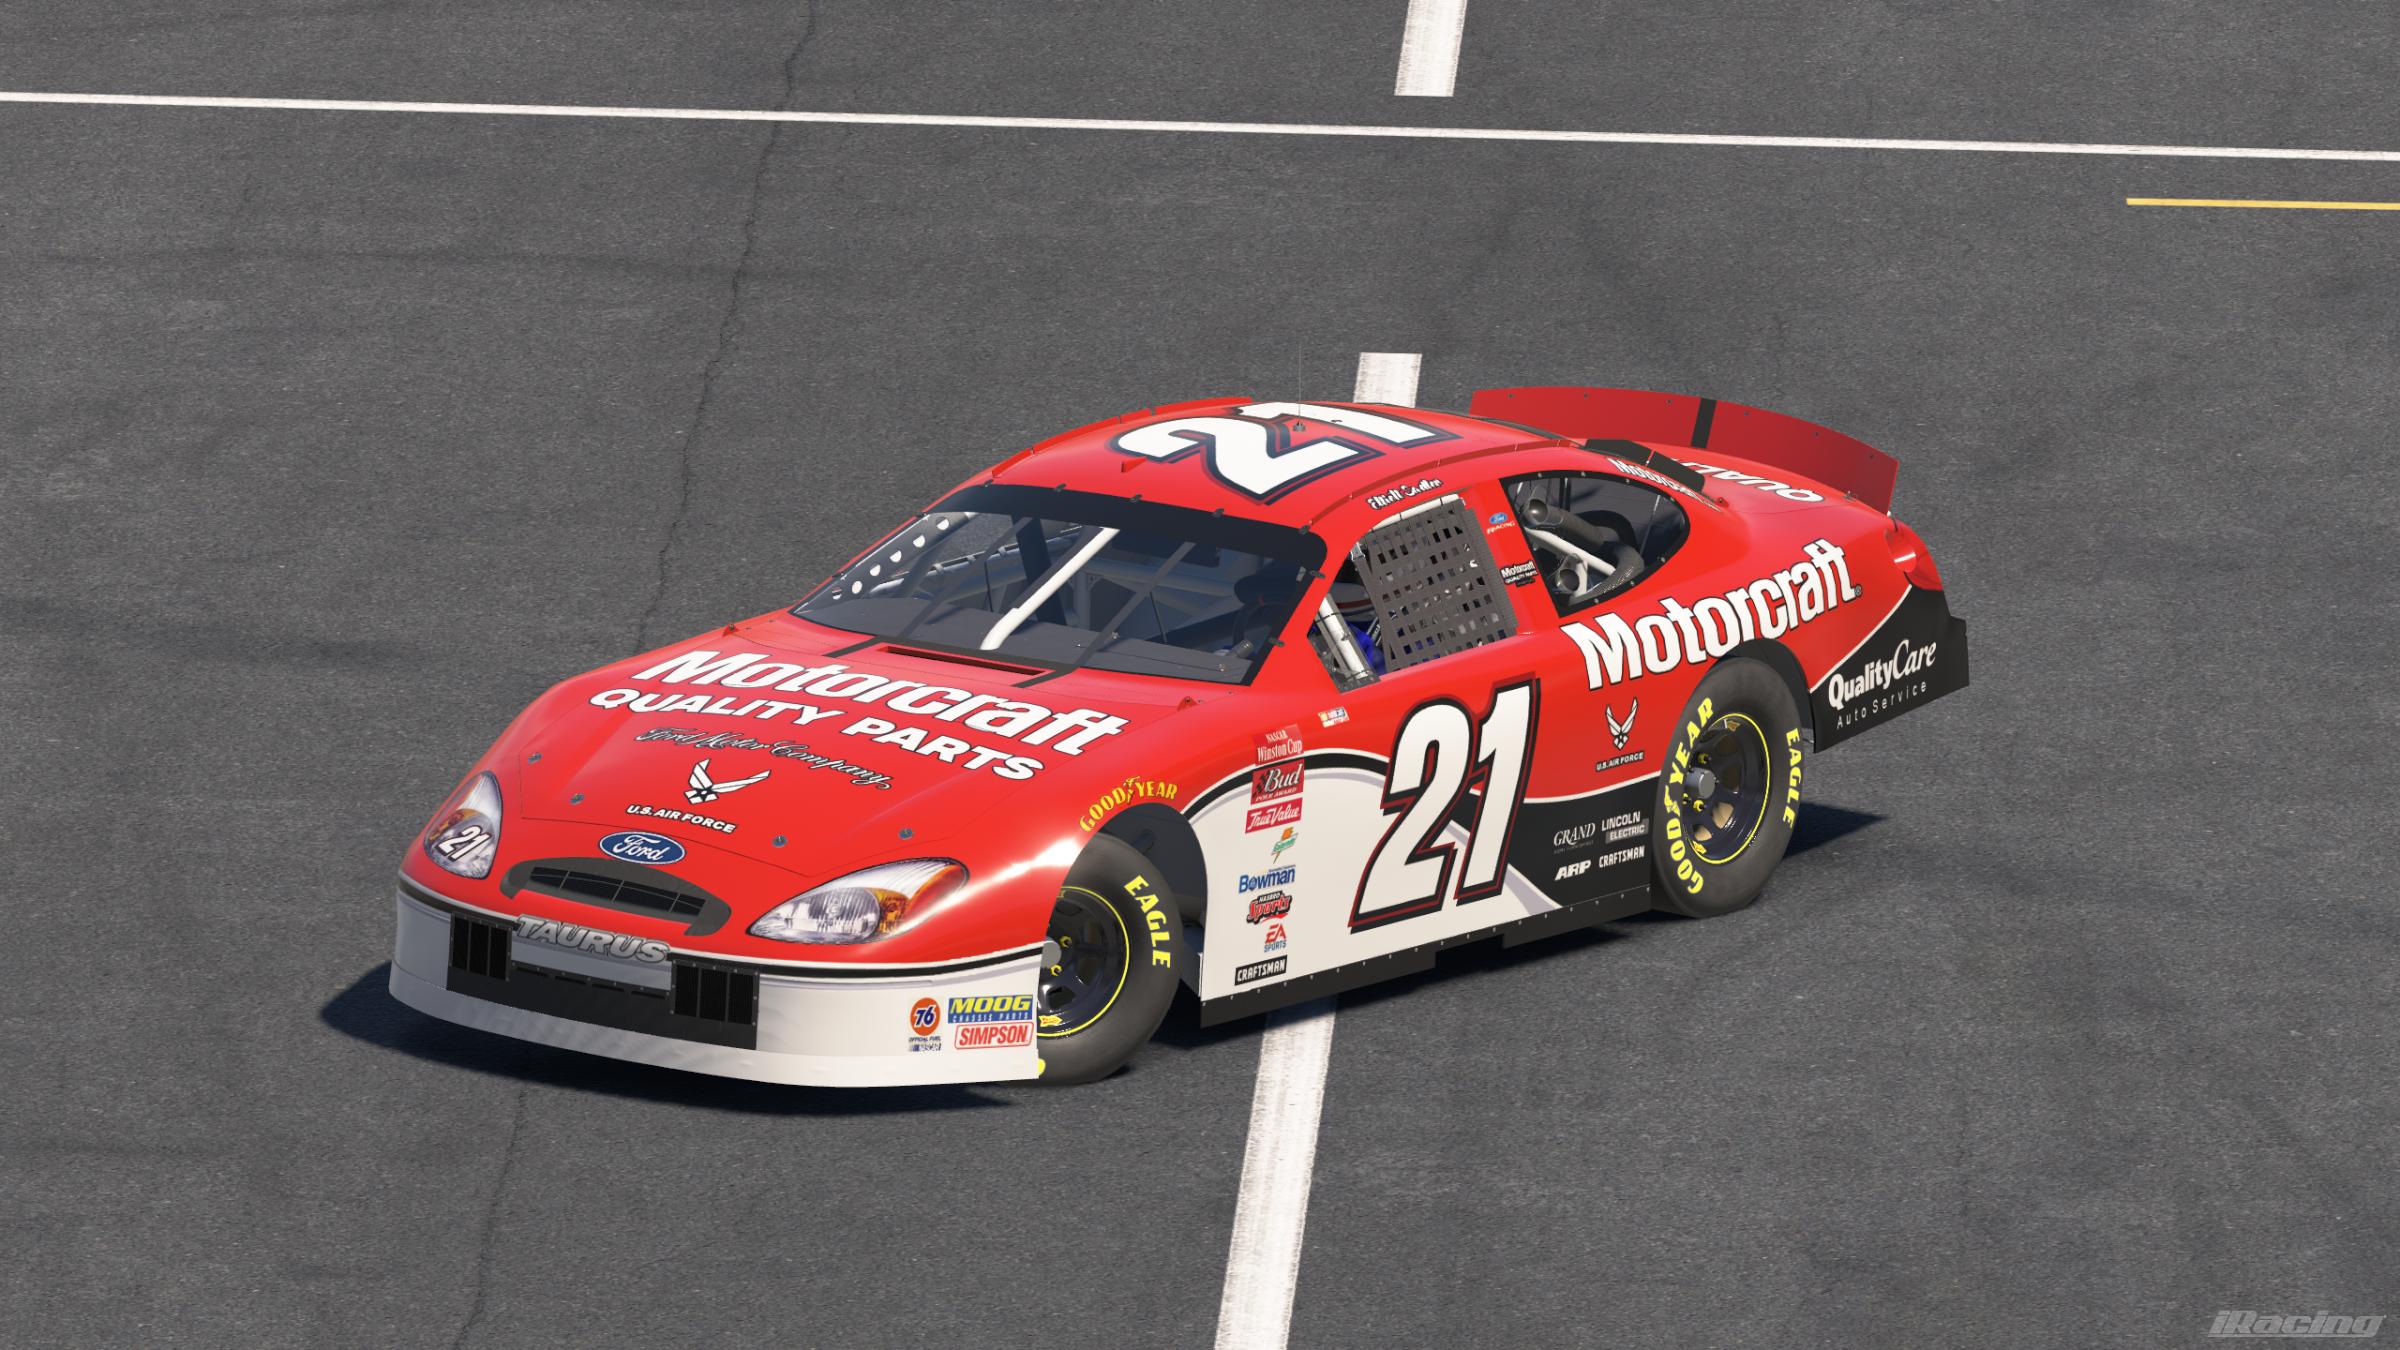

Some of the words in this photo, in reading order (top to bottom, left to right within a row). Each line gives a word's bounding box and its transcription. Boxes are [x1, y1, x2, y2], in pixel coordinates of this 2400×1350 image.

[1110, 401, 1458, 503] 21
[1560, 538, 1857, 691] Motorcraft
[630, 650, 1132, 756] Motorcraft
[1836, 707, 1867, 730] Auto
[1872, 681, 1927, 713] Service
[588, 688, 848, 726] QUALITY
[841, 716, 1046, 781] PARTS
[634, 727, 700, 746] Ford
[695, 731, 772, 751] Motor
[770, 740, 892, 790] Company
[1257, 743, 1288, 763] Winston
[1287, 737, 1304, 755] Cup
[1620, 751, 1645, 765] FORCE
[1264, 763, 1304, 793] Bud
[1782, 727, 1802, 829] EAGLE
[1349, 674, 1540, 932] 21
[626, 803, 655, 817] U.S.
[654, 807, 684, 823] AIR
[680, 810, 737, 834] FORCE
[1601, 810, 1641, 832] LINCOLN
[436, 824, 493, 864] 21
[1553, 822, 1596, 847] GRAND
[1609, 824, 1645, 841] ELECTRIC
[611, 833, 671, 862] Ford
[1599, 845, 1646, 868] CRAFTSMAN
[1238, 867, 1296, 894] Bowman
[1554, 859, 1592, 881] ARP
[1124, 875, 1171, 968] EAGLE
[1264, 923, 1287, 944] EA
[515, 914, 671, 964] TAURUS
[1263, 940, 1287, 953] SPORTS
[1236, 958, 1287, 983] CRAFTSMAN
[914, 1003, 937, 1028] 76
[950, 995, 1033, 1015] MOOG
[952, 1013, 992, 1023] CHASSIS
[999, 1011, 1029, 1021] PARTS
[959, 1024, 1029, 1047] SIMPSON
